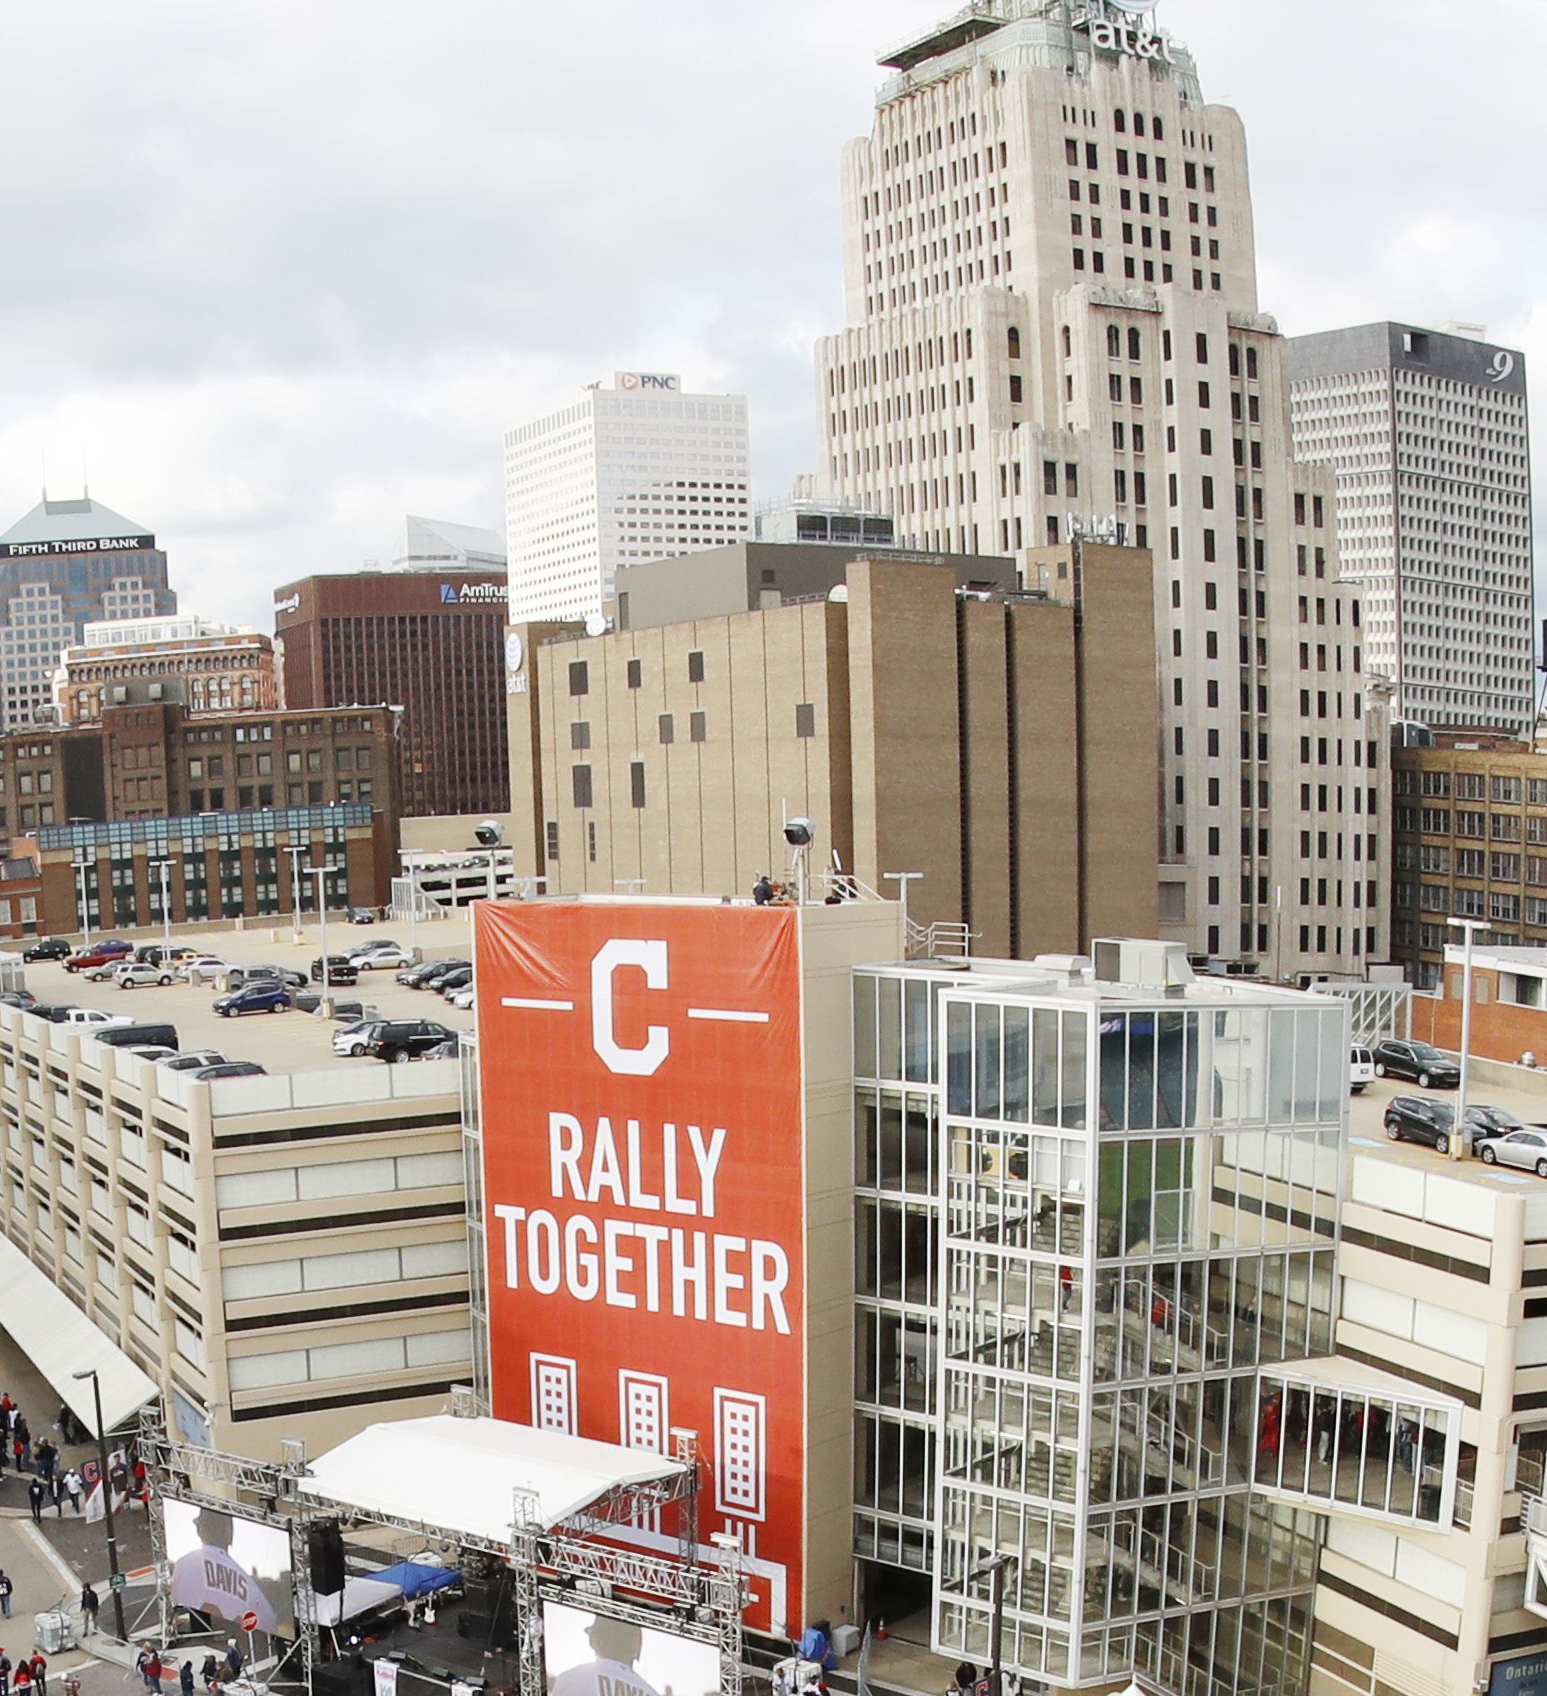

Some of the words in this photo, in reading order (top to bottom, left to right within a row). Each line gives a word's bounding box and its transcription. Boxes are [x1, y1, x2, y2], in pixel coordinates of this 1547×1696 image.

[1092, 14, 1176, 65] at&t
[1492, 351, 1514, 382] 9
[9, 544, 49, 556] FIFTH
[51, 540, 96, 553] THIRD
[99, 538, 140, 550] BANK
[590, 938, 670, 1076] C
[548, 1111, 727, 1219] RALLY
[494, 1203, 791, 1336] TOGETHER
[204, 1559, 248, 1601] DAVIS
